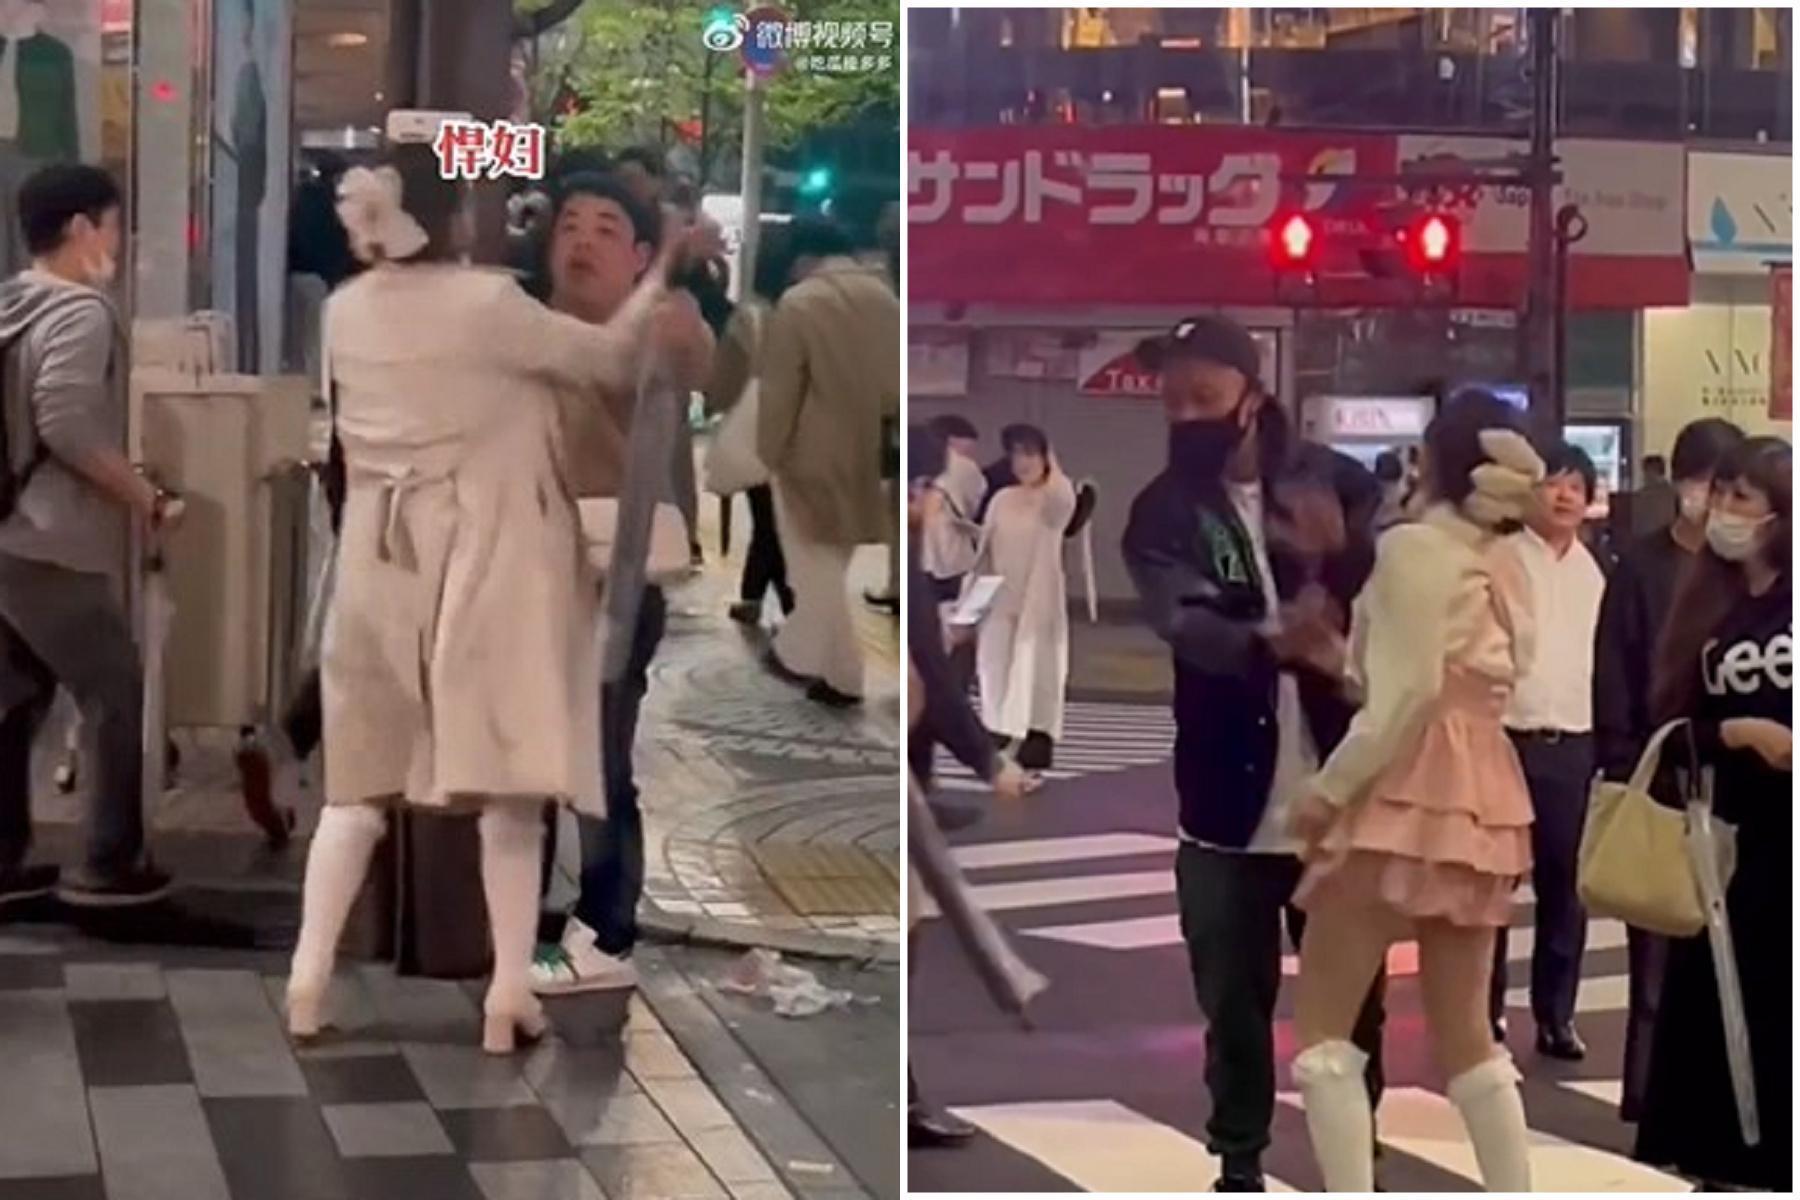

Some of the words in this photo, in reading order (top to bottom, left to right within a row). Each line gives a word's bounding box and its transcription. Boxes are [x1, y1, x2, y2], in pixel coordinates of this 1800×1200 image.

[908, 150, 1281, 226] サンドラッグ
